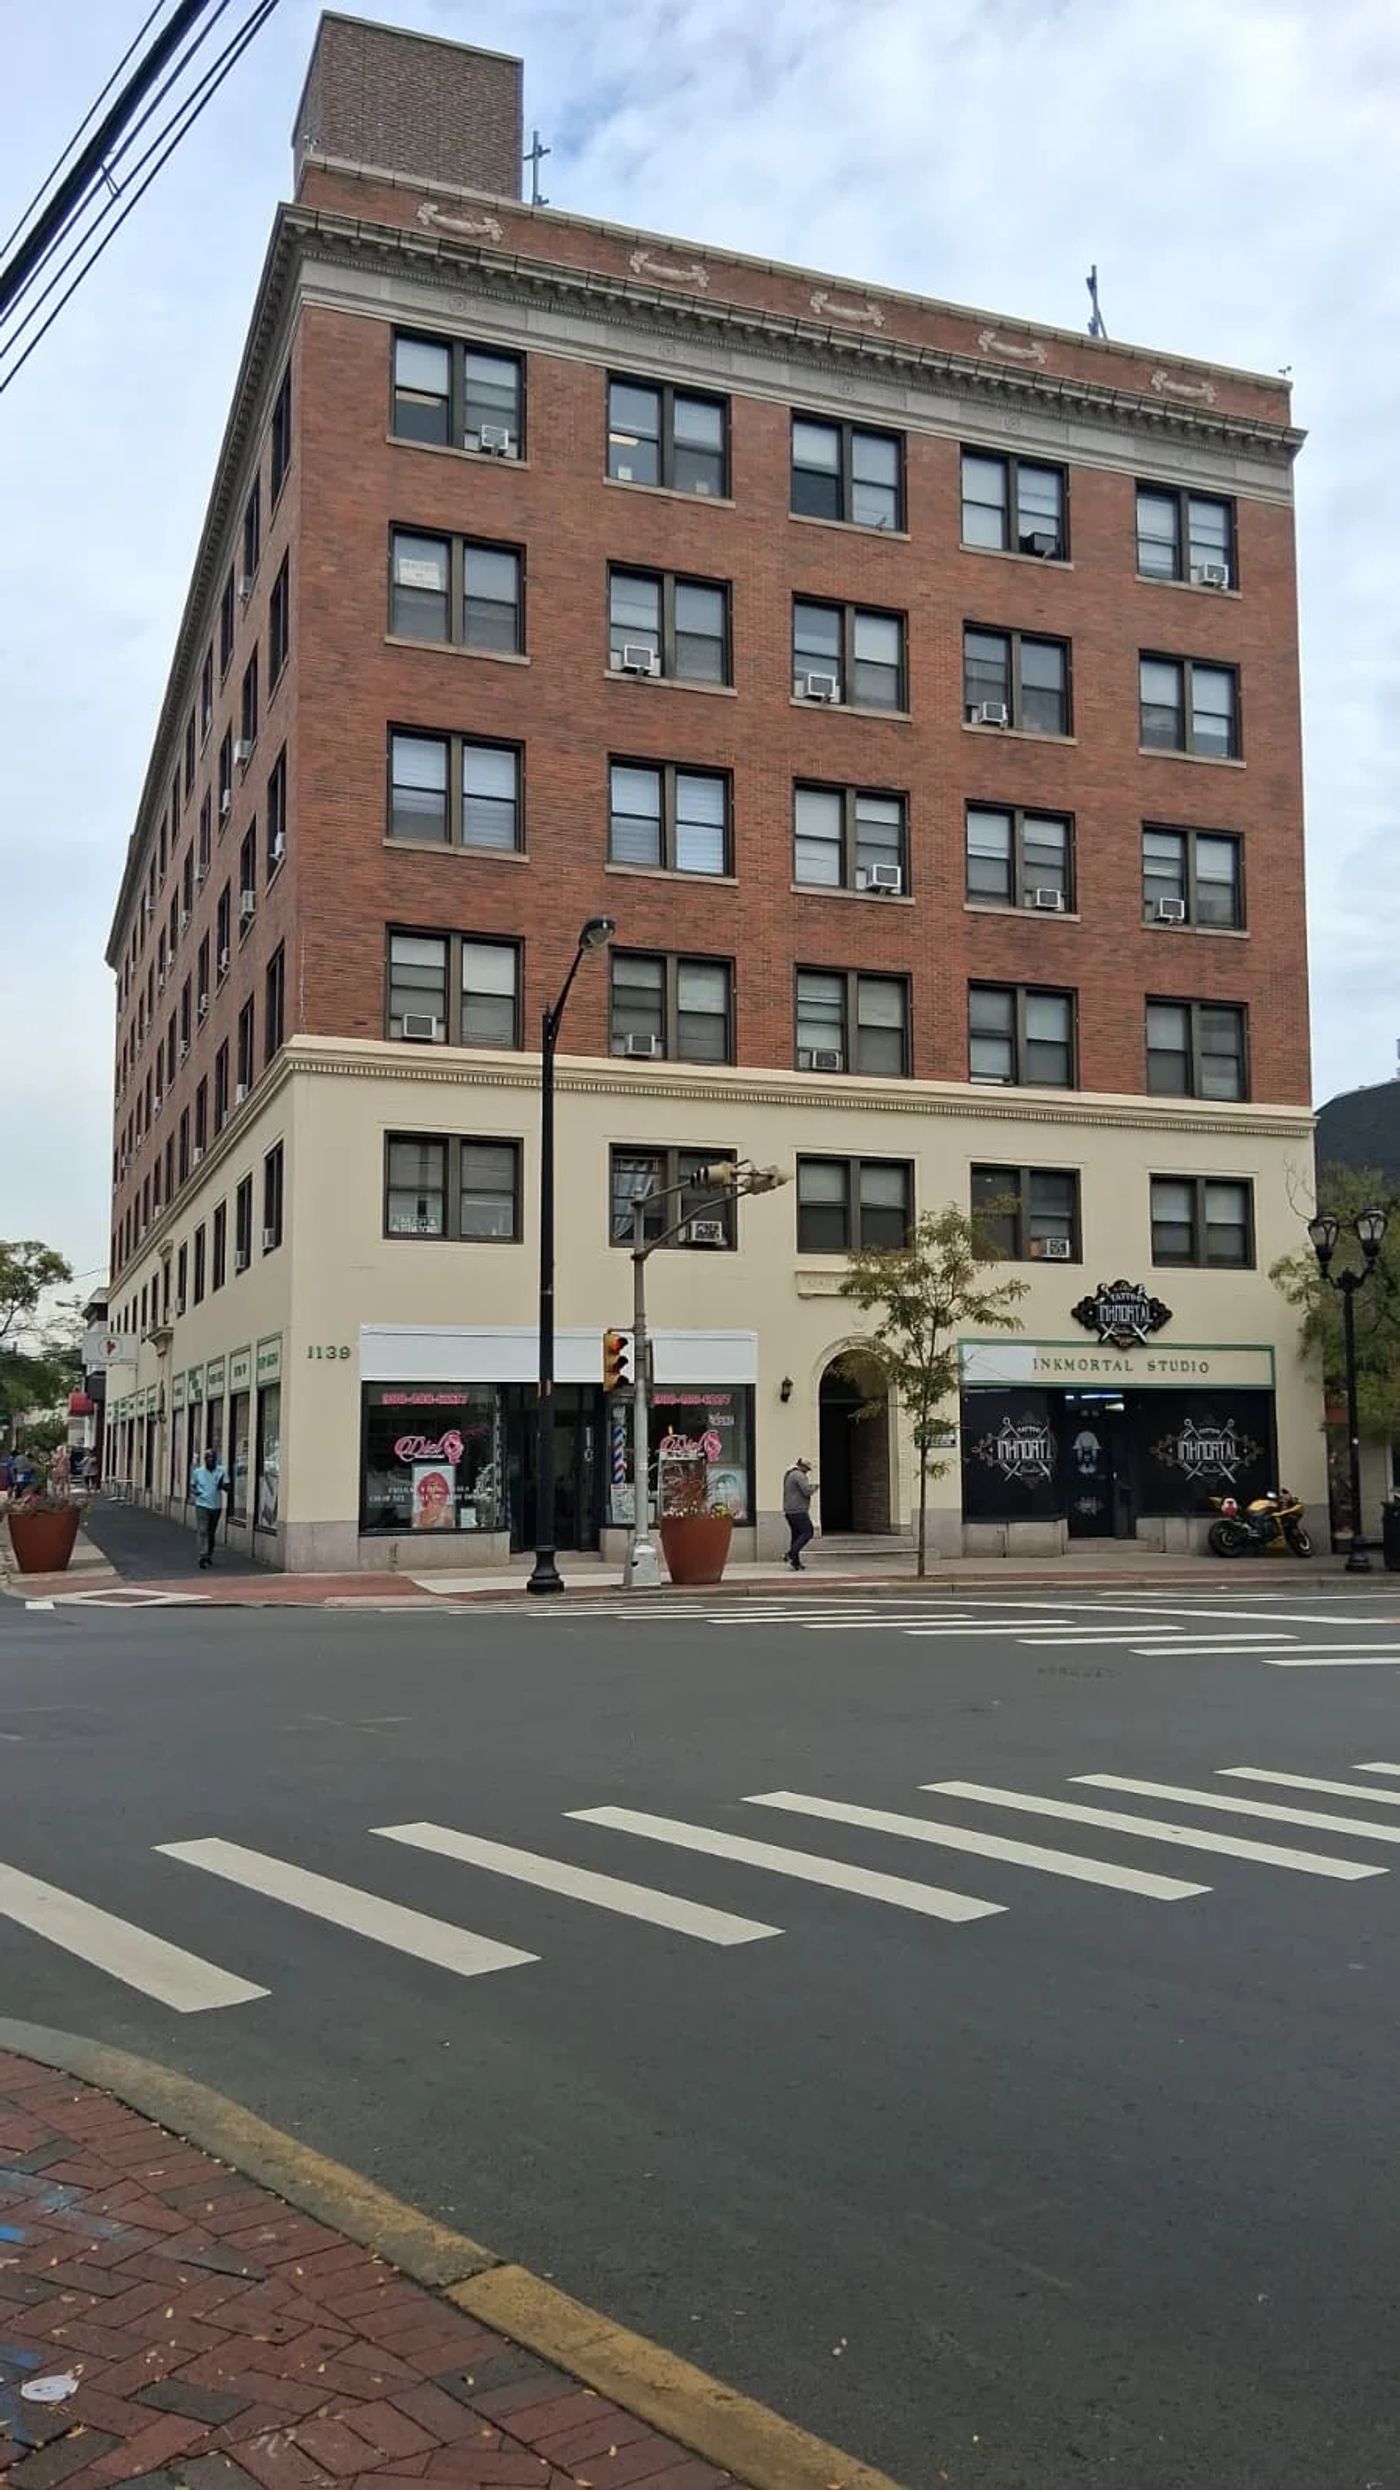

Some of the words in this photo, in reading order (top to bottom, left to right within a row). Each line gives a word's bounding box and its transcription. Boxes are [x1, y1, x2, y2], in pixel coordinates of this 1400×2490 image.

[1032, 1357, 1134, 1373] INKMORTAL
[1147, 1359, 1210, 1374] STUDIO
[1177, 1439, 1241, 1461] INKMORTAL
